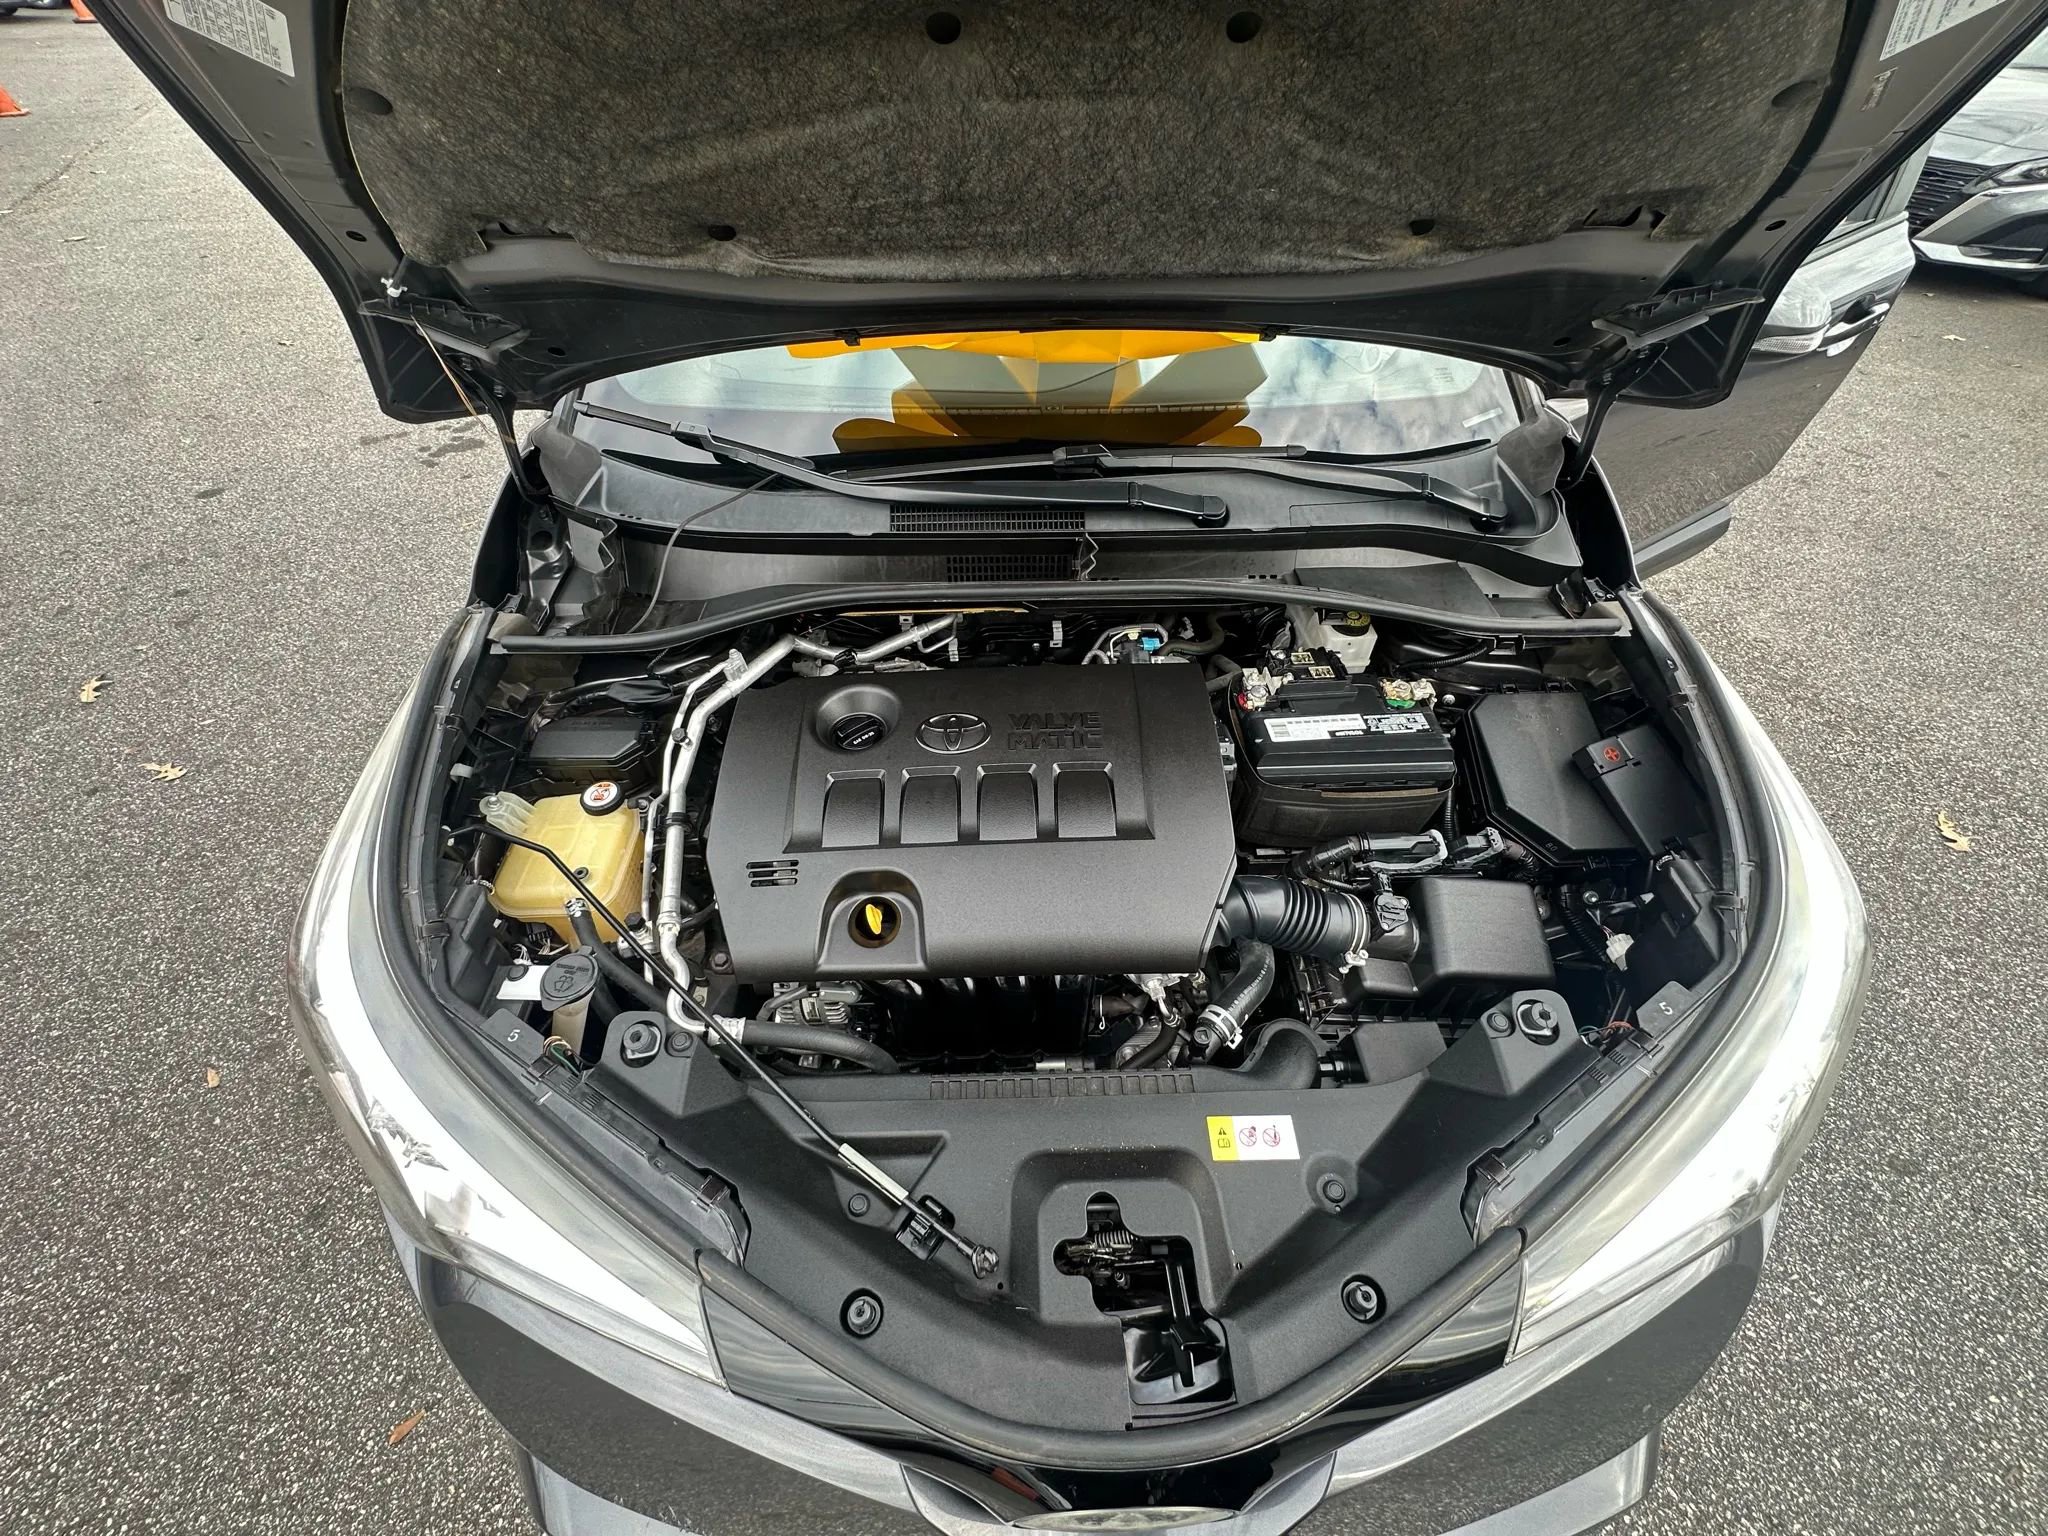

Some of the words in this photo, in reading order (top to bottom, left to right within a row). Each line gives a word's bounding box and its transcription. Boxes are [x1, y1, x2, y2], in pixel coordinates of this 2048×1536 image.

[1007, 712, 1101, 730] VALVE
[1007, 731, 1104, 751] MATIC
[1659, 1001, 1673, 1016] 5
[508, 1029, 521, 1042] 5
